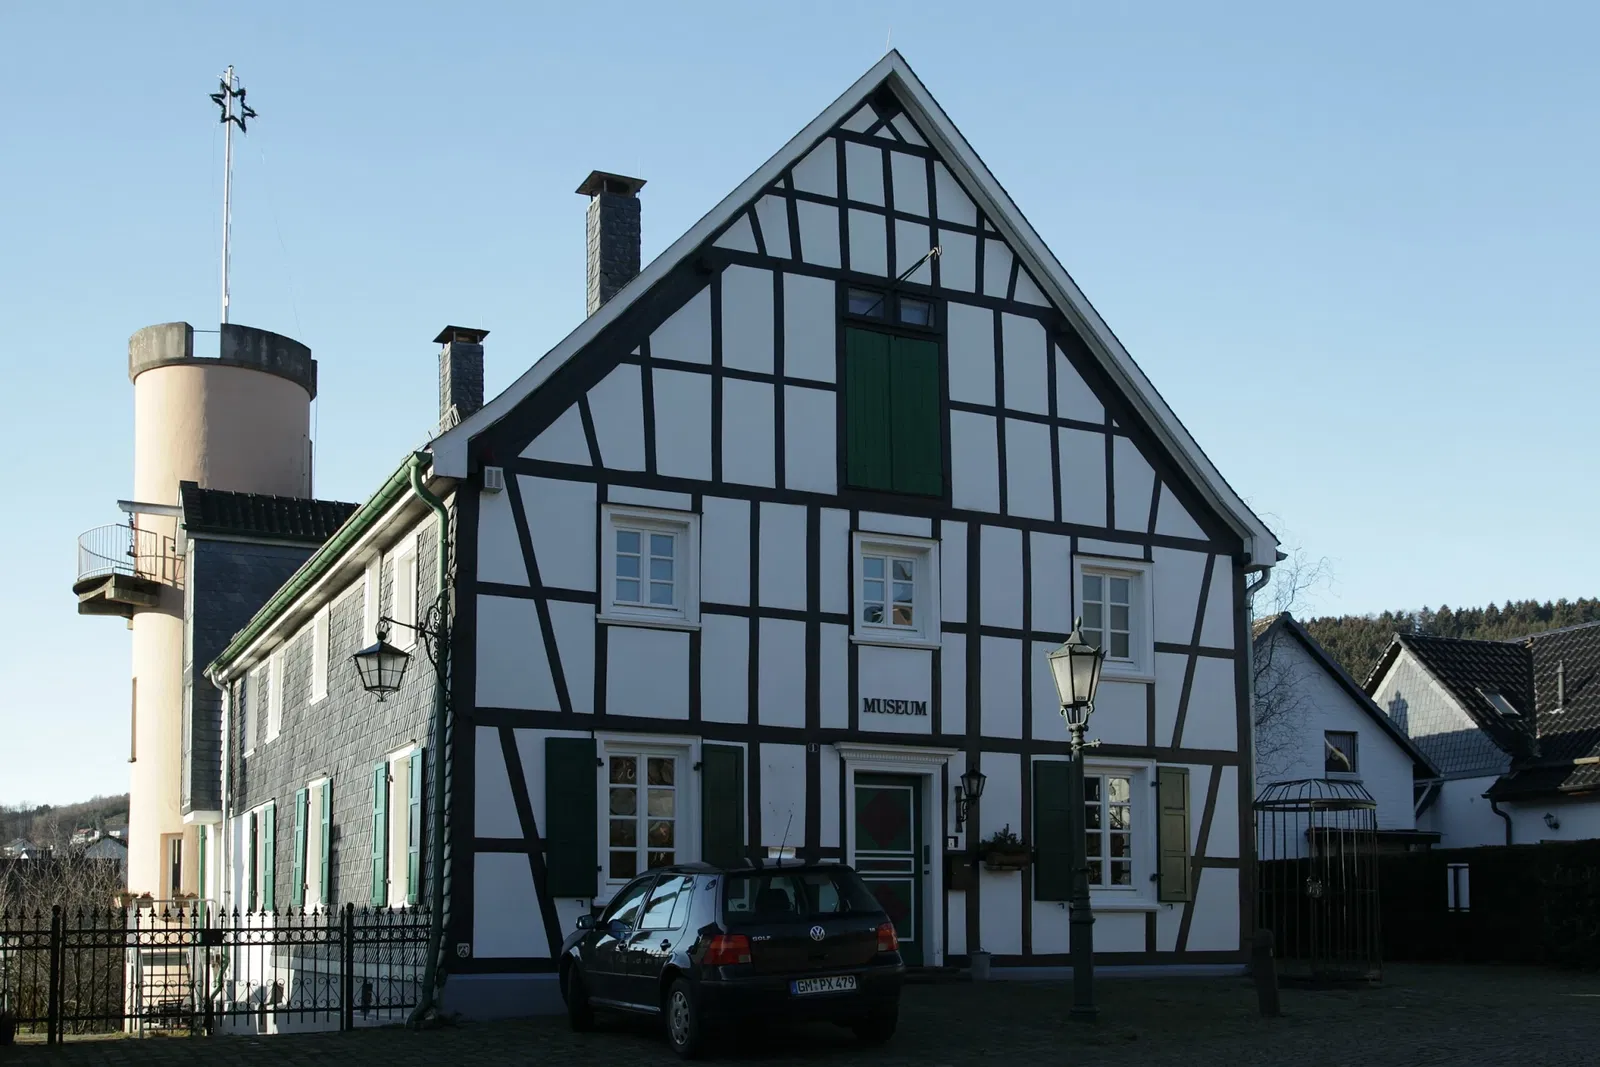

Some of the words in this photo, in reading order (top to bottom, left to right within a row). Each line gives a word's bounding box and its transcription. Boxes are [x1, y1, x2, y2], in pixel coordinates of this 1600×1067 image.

[863, 697, 928, 716] MUSEUM
[797, 980, 813, 993] GM
[819, 977, 834, 990] PX
[836, 976, 855, 989] 479
